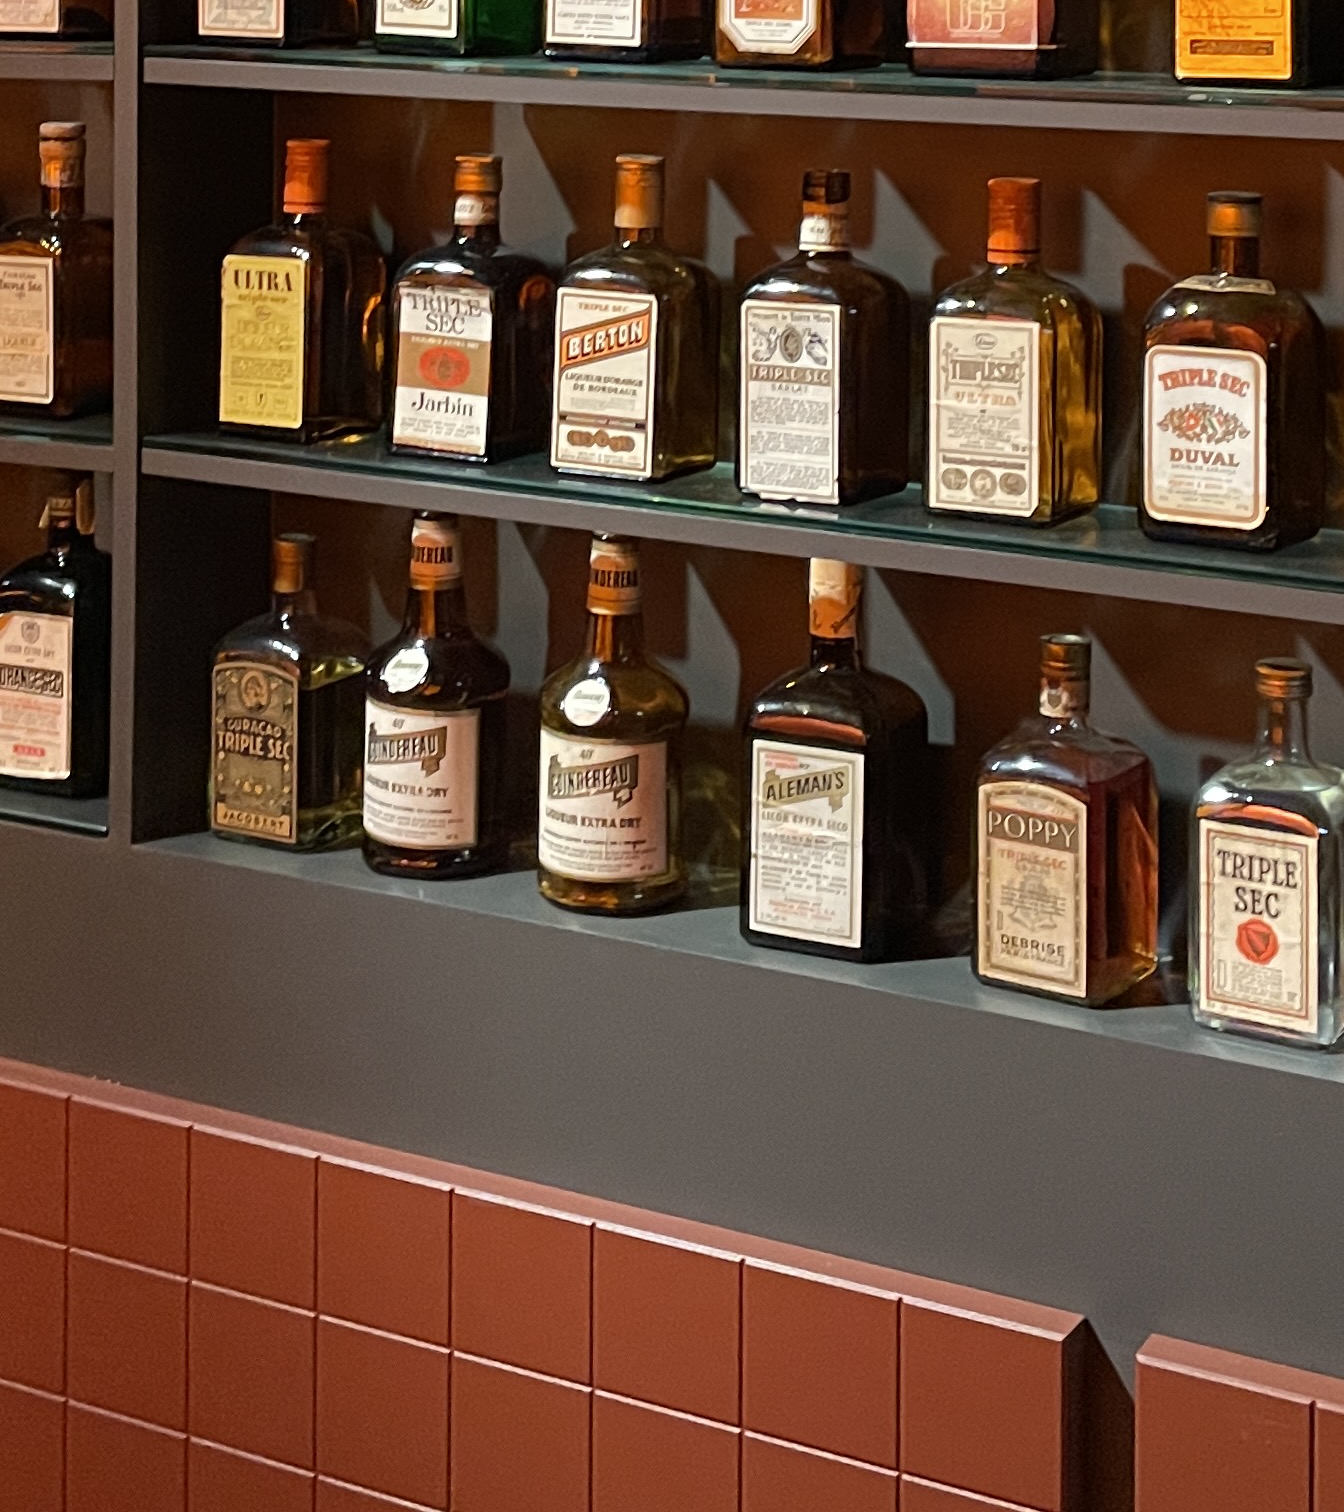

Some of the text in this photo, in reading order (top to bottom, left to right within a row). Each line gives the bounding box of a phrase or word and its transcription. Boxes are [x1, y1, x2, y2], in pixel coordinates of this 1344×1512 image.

[233, 268, 293, 293] ULTRA
[407, 292, 482, 319] TRIPLE
[578, 302, 610, 311] TRIPLE
[426, 313, 465, 335] SEC
[567, 318, 644, 361] BERTON
[572, 382, 588, 392] DE
[751, 366, 830, 385] TRIPLE SEC
[1158, 368, 1250, 399] TRIPLE SEC
[1170, 448, 1241, 469] DUVAL
[217, 731, 291, 761] TRIPLE SEC
[766, 770, 845, 802] ALEMAN'S
[580, 815, 643, 829] EXTRA DRY
[988, 810, 1077, 848] POPPY
[1216, 849, 1299, 889] TRIPLE
[1234, 887, 1280, 919] SEC
[1000, 934, 1065, 957] DEBRISE
